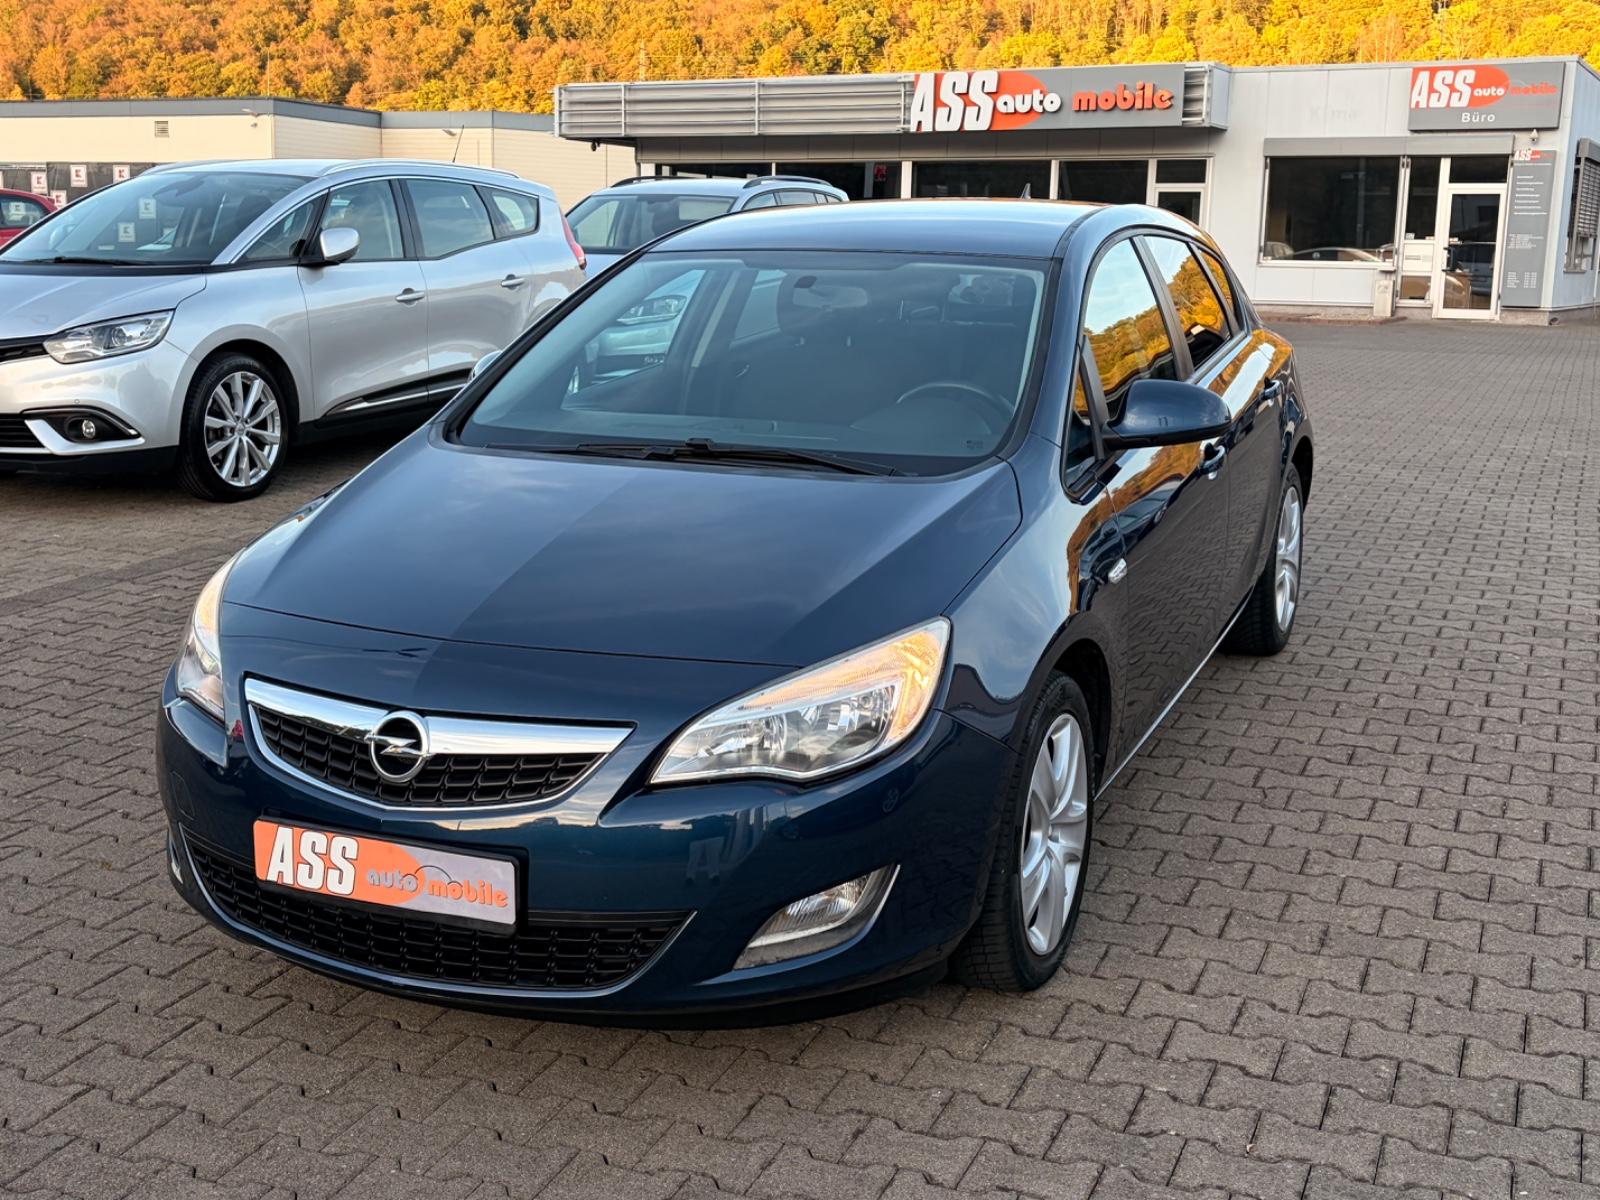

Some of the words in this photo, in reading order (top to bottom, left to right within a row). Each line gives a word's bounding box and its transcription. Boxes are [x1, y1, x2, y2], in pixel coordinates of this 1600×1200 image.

[909, 70, 998, 132] ASS
[996, 89, 1062, 113] auto
[1072, 81, 1174, 111] mobile
[1410, 69, 1476, 109] ASS
[1473, 85, 1505, 97] auto
[1461, 112, 1496, 123] Büro
[266, 825, 359, 895] ASS
[366, 868, 419, 893] auto
[427, 879, 508, 908] mobile
